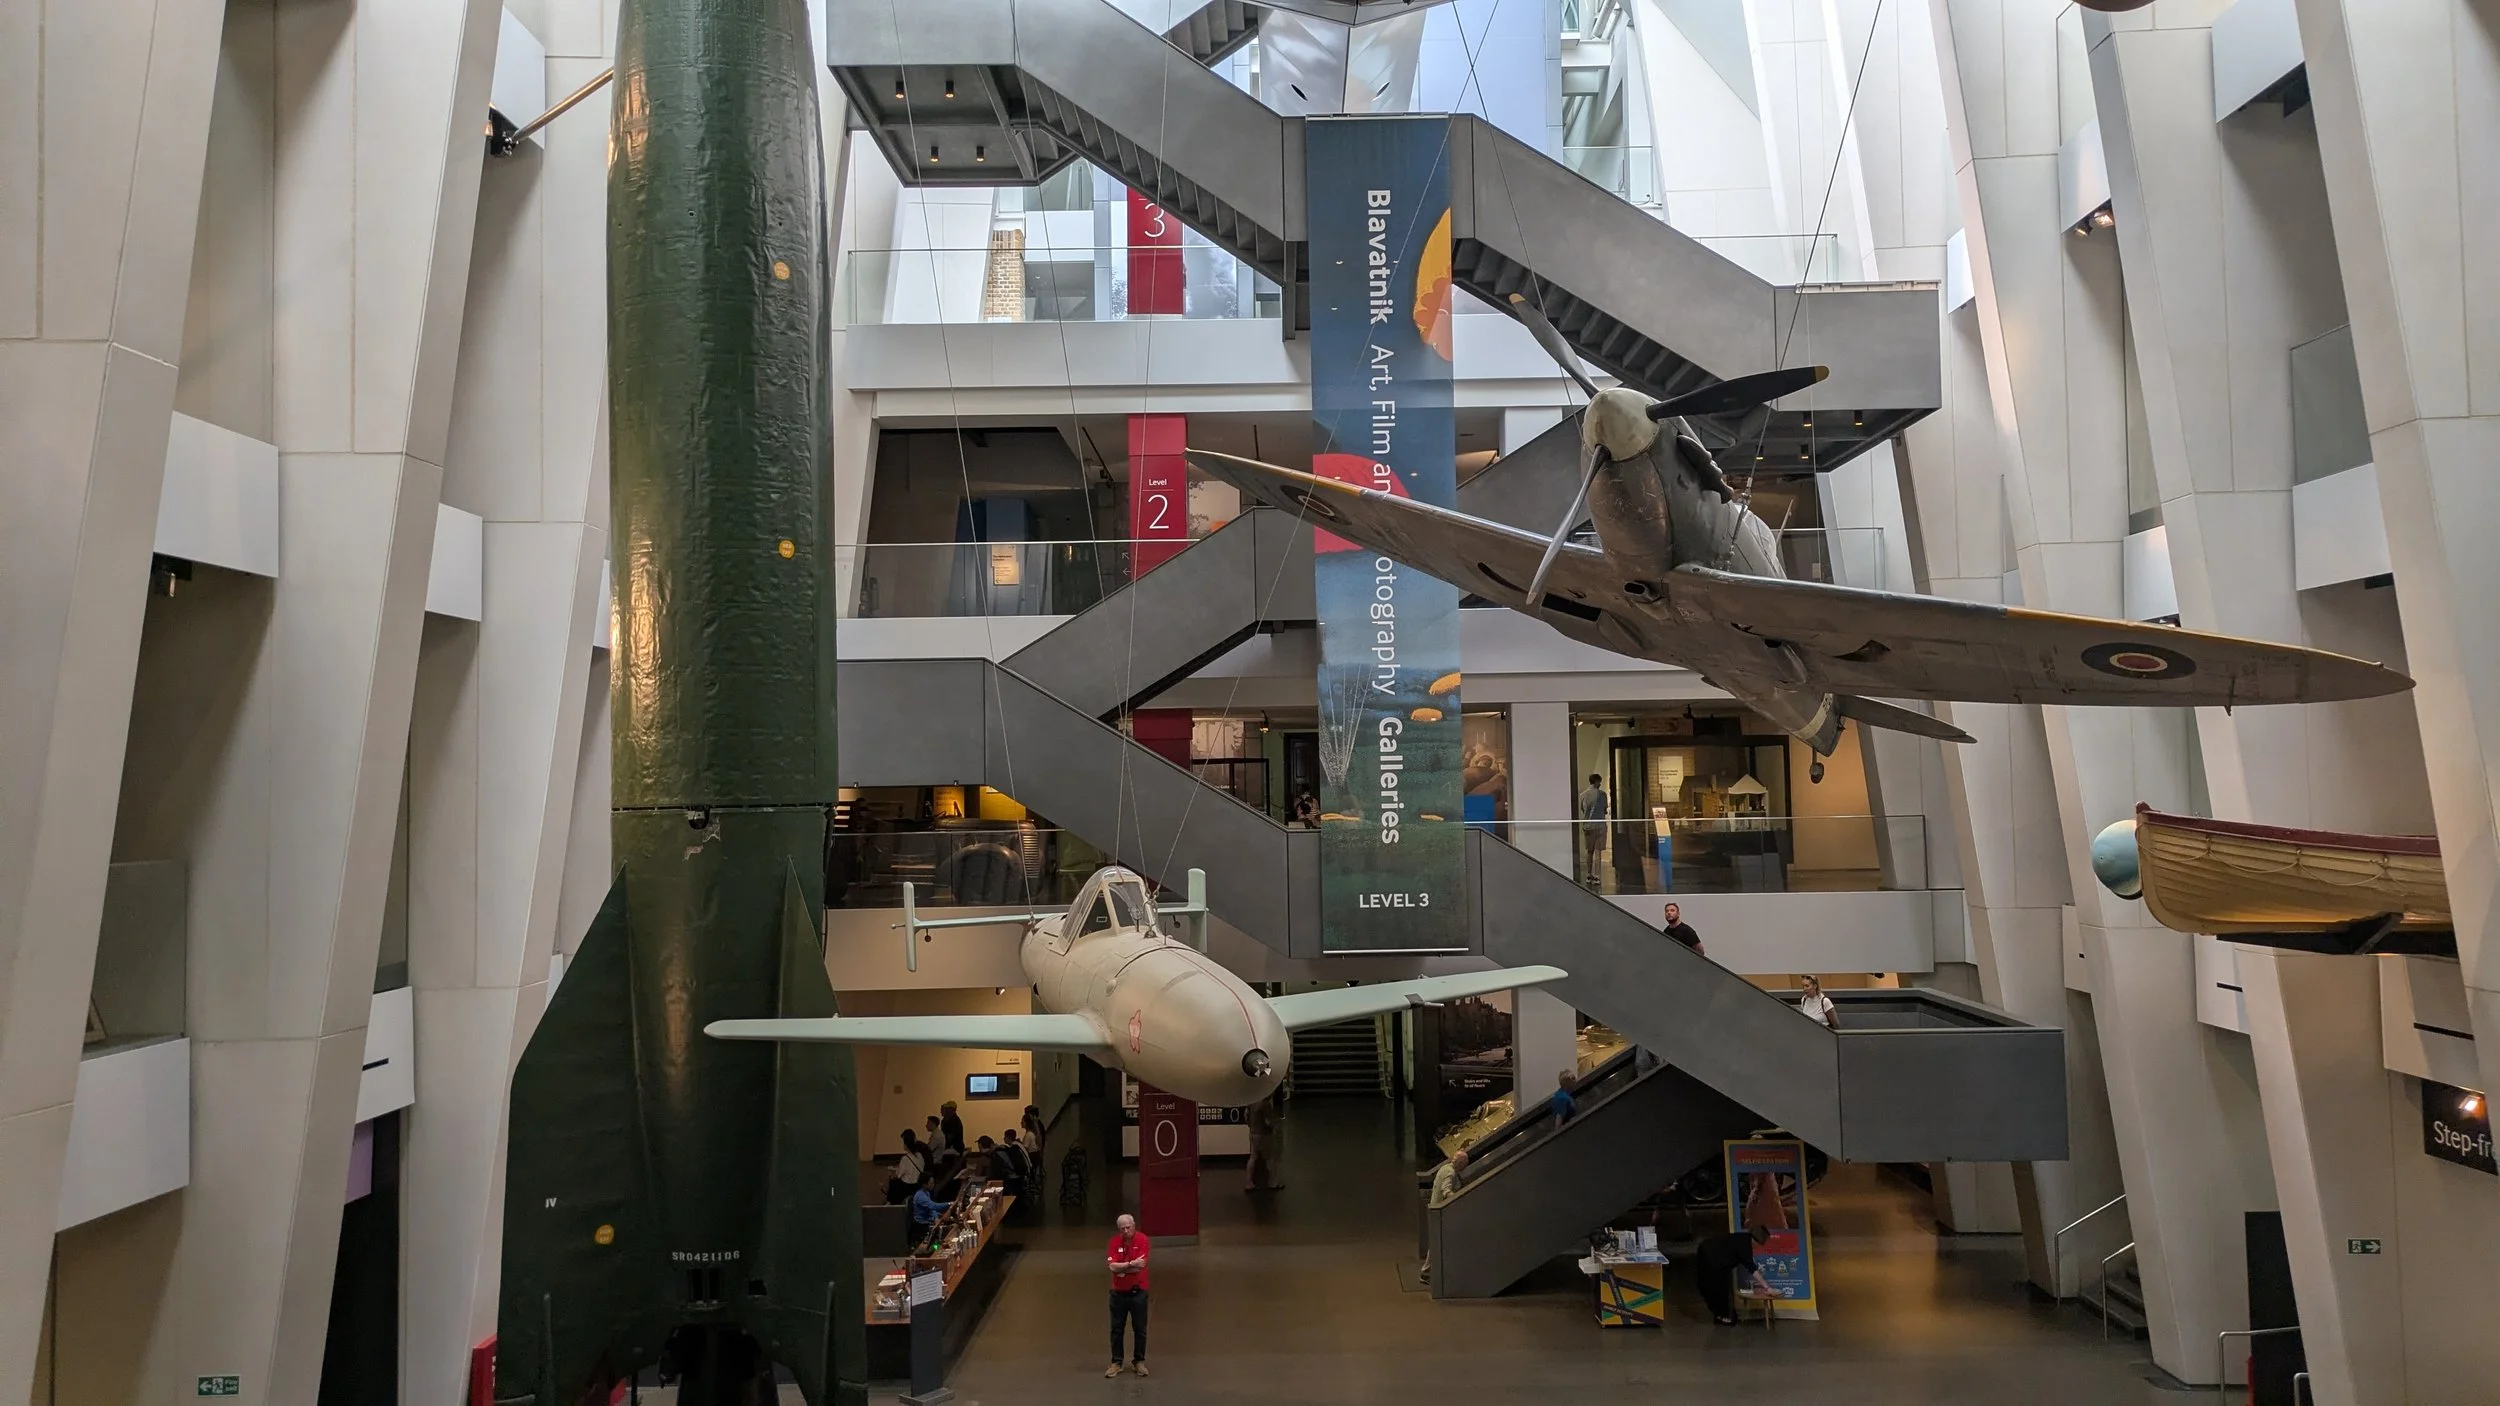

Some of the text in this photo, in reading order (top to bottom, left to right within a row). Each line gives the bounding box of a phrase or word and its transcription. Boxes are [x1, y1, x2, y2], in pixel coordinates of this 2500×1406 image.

[1144, 202, 1166, 238] 3
[1148, 478, 1168, 487] Level
[1147, 494, 1170, 530] 2
[1367, 189, 1405, 845] Blavatnik Art, Film an otography Galleries
[1359, 893, 1430, 909] LEVEL 3
[1156, 1102, 1176, 1111] Level
[1154, 1119, 1178, 1157] 0
[2433, 1120, 2492, 1158] Step-fr
